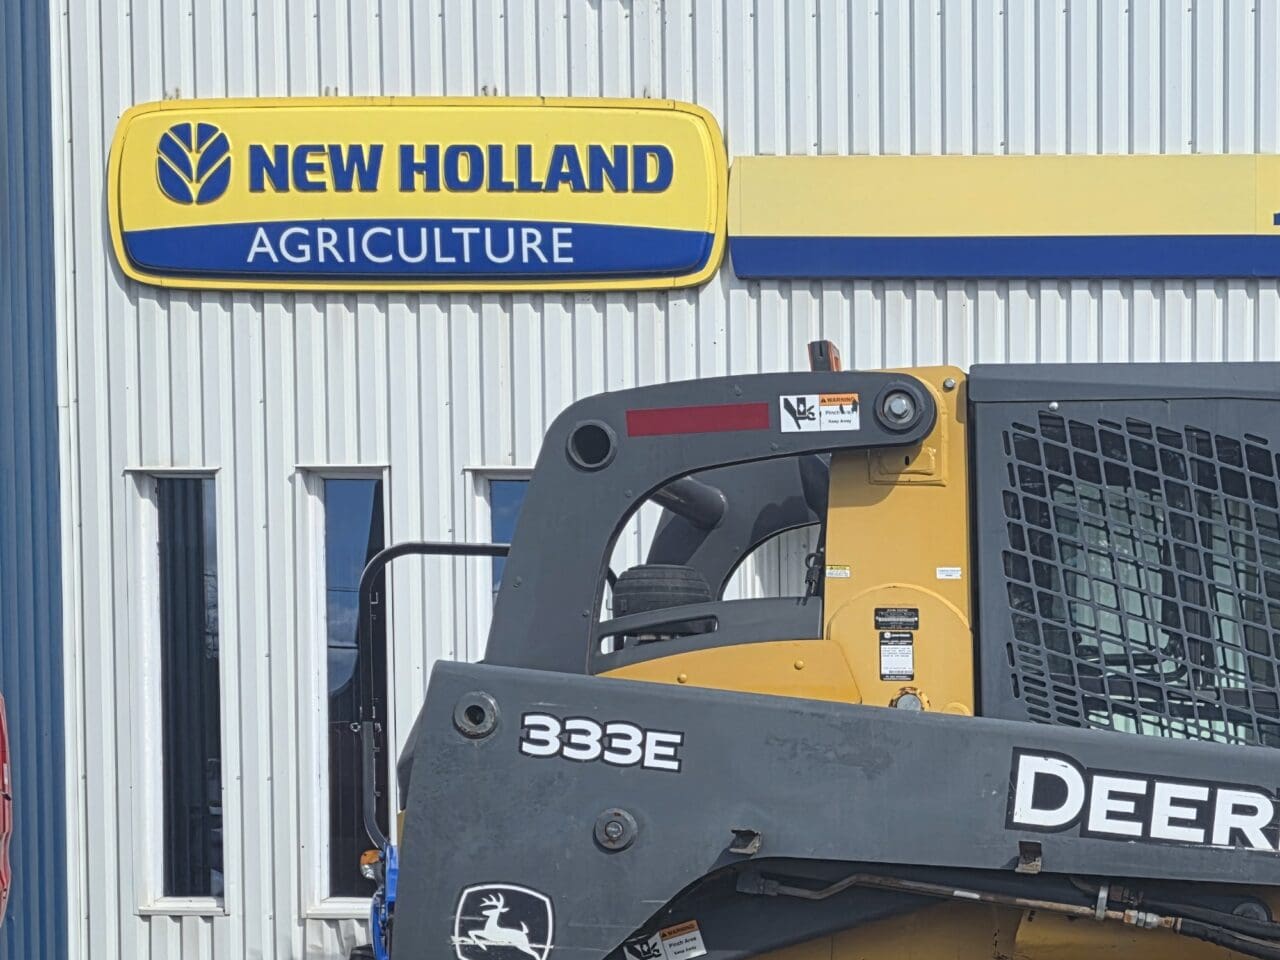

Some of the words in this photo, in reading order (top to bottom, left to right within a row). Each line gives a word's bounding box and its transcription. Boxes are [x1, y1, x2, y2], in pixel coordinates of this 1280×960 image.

[249, 144, 384, 193] NEW
[400, 144, 674, 193] HOLLAND
[246, 226, 575, 264] AGRICULTURE
[521, 714, 682, 770] 333E
